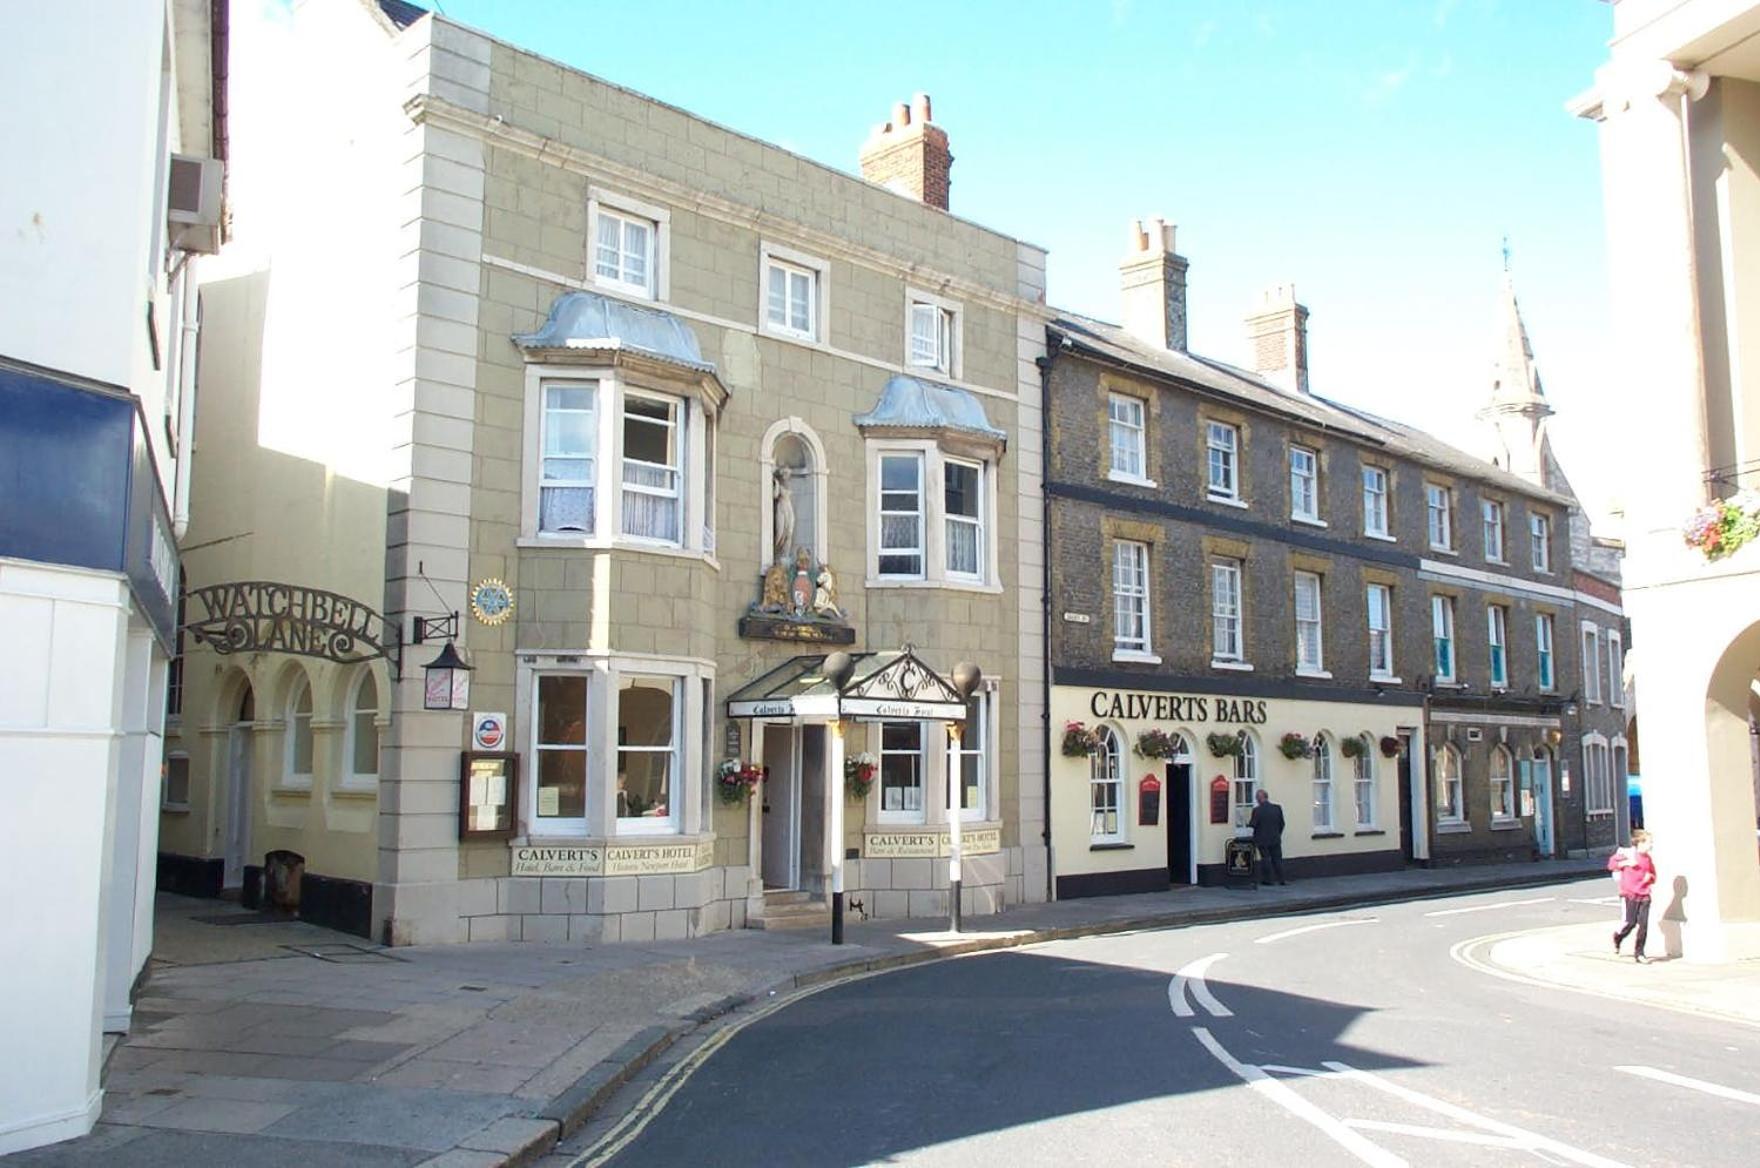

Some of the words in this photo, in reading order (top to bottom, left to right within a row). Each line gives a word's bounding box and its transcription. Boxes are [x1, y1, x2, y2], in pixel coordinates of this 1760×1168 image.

[200, 585, 380, 641] WATCHBELL
[253, 618, 329, 656] LANE
[1091, 691, 1208, 722] CALVERTS
[1215, 698, 1267, 725] BARS
[870, 835, 935, 846] CALVERT'S
[518, 849, 599, 861] CALVERT'S
[607, 848, 660, 861] CALVERT'S
[662, 847, 693, 859] HOTEL
